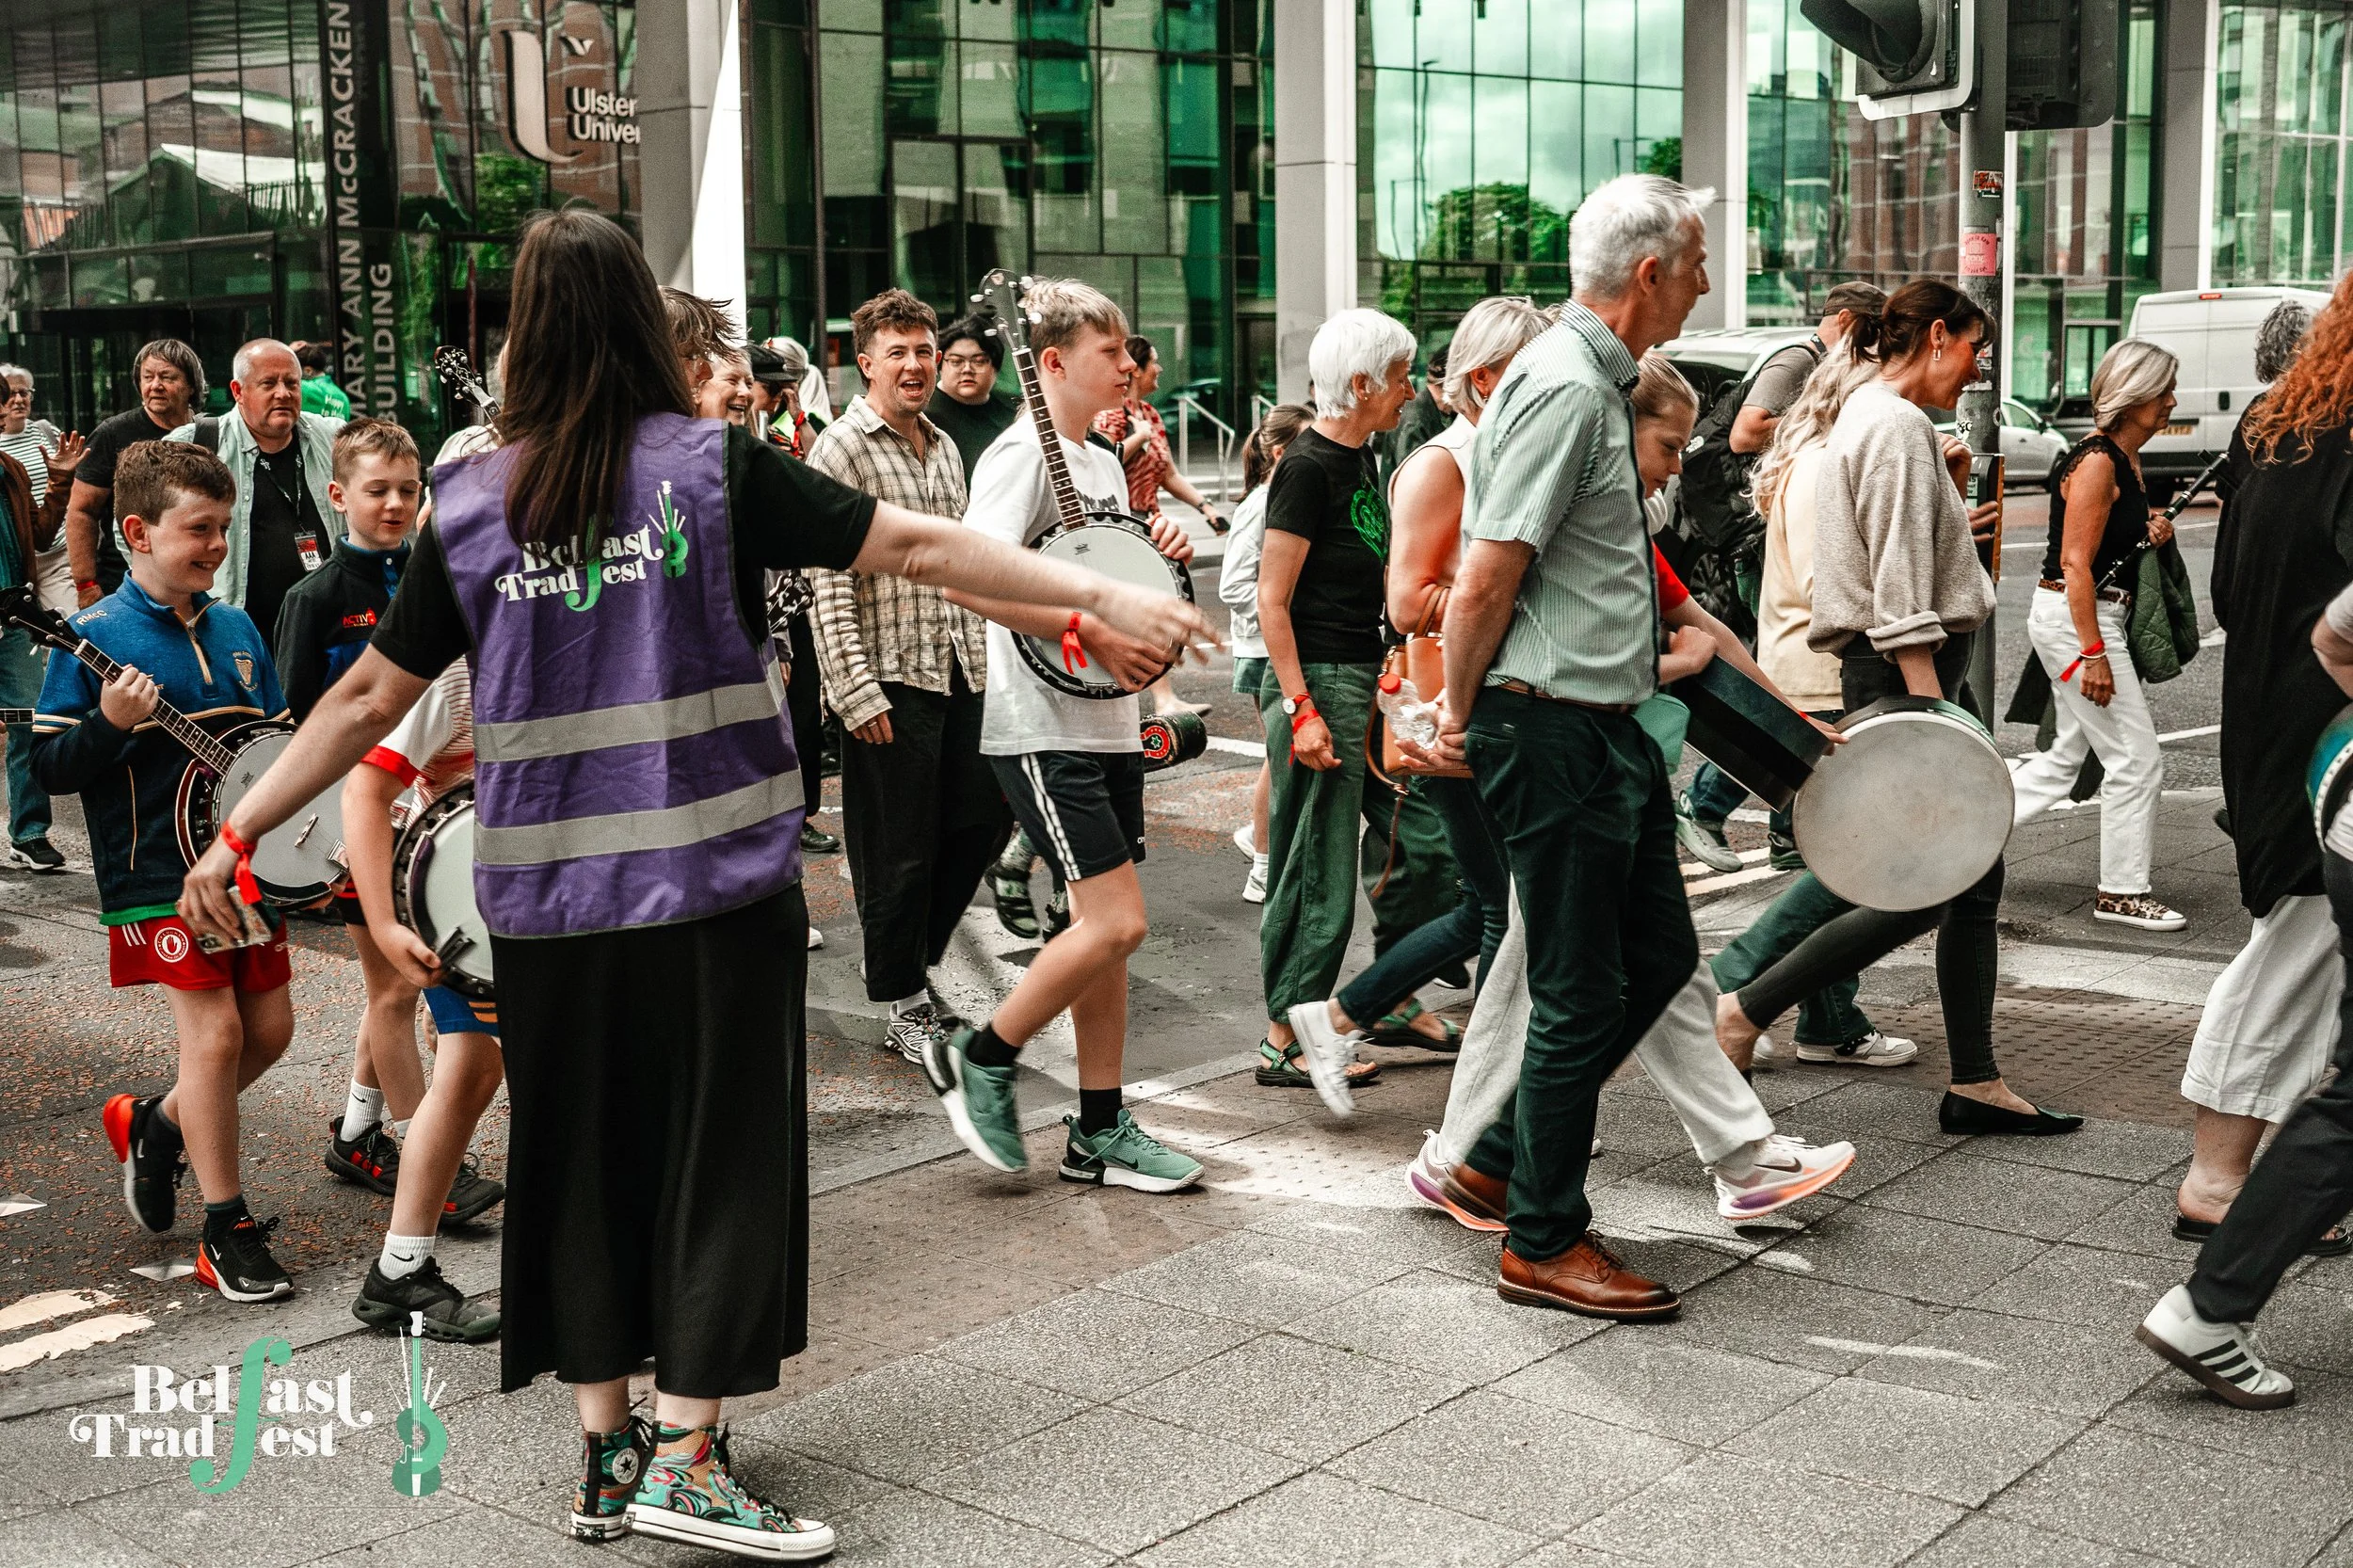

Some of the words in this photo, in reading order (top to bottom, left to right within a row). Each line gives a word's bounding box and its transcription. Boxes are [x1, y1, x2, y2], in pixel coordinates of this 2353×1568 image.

[328, 2, 360, 227] McCRACKEN
[572, 86, 637, 117] Ulster
[339, 239, 362, 319] ANN
